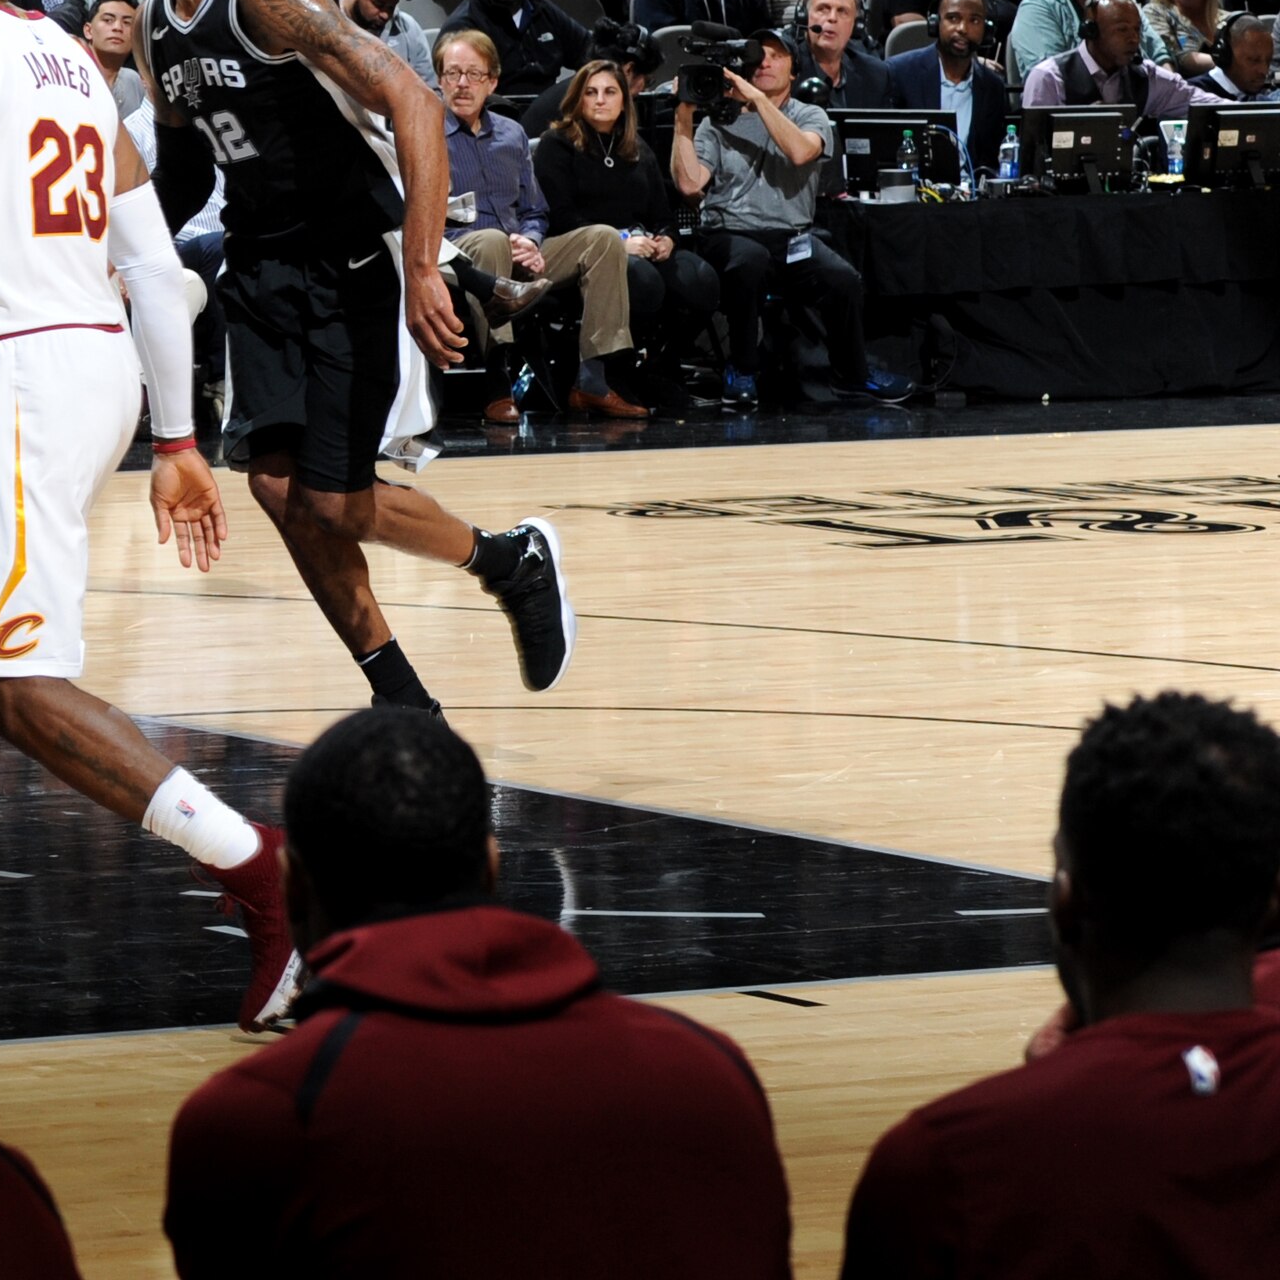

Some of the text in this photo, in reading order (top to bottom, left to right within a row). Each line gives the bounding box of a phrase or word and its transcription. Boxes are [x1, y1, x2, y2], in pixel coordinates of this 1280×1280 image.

[22, 52, 91, 99] JAMES
[161, 57, 247, 106] SPURS
[194, 109, 260, 165] 12
[28, 117, 109, 243] 23
